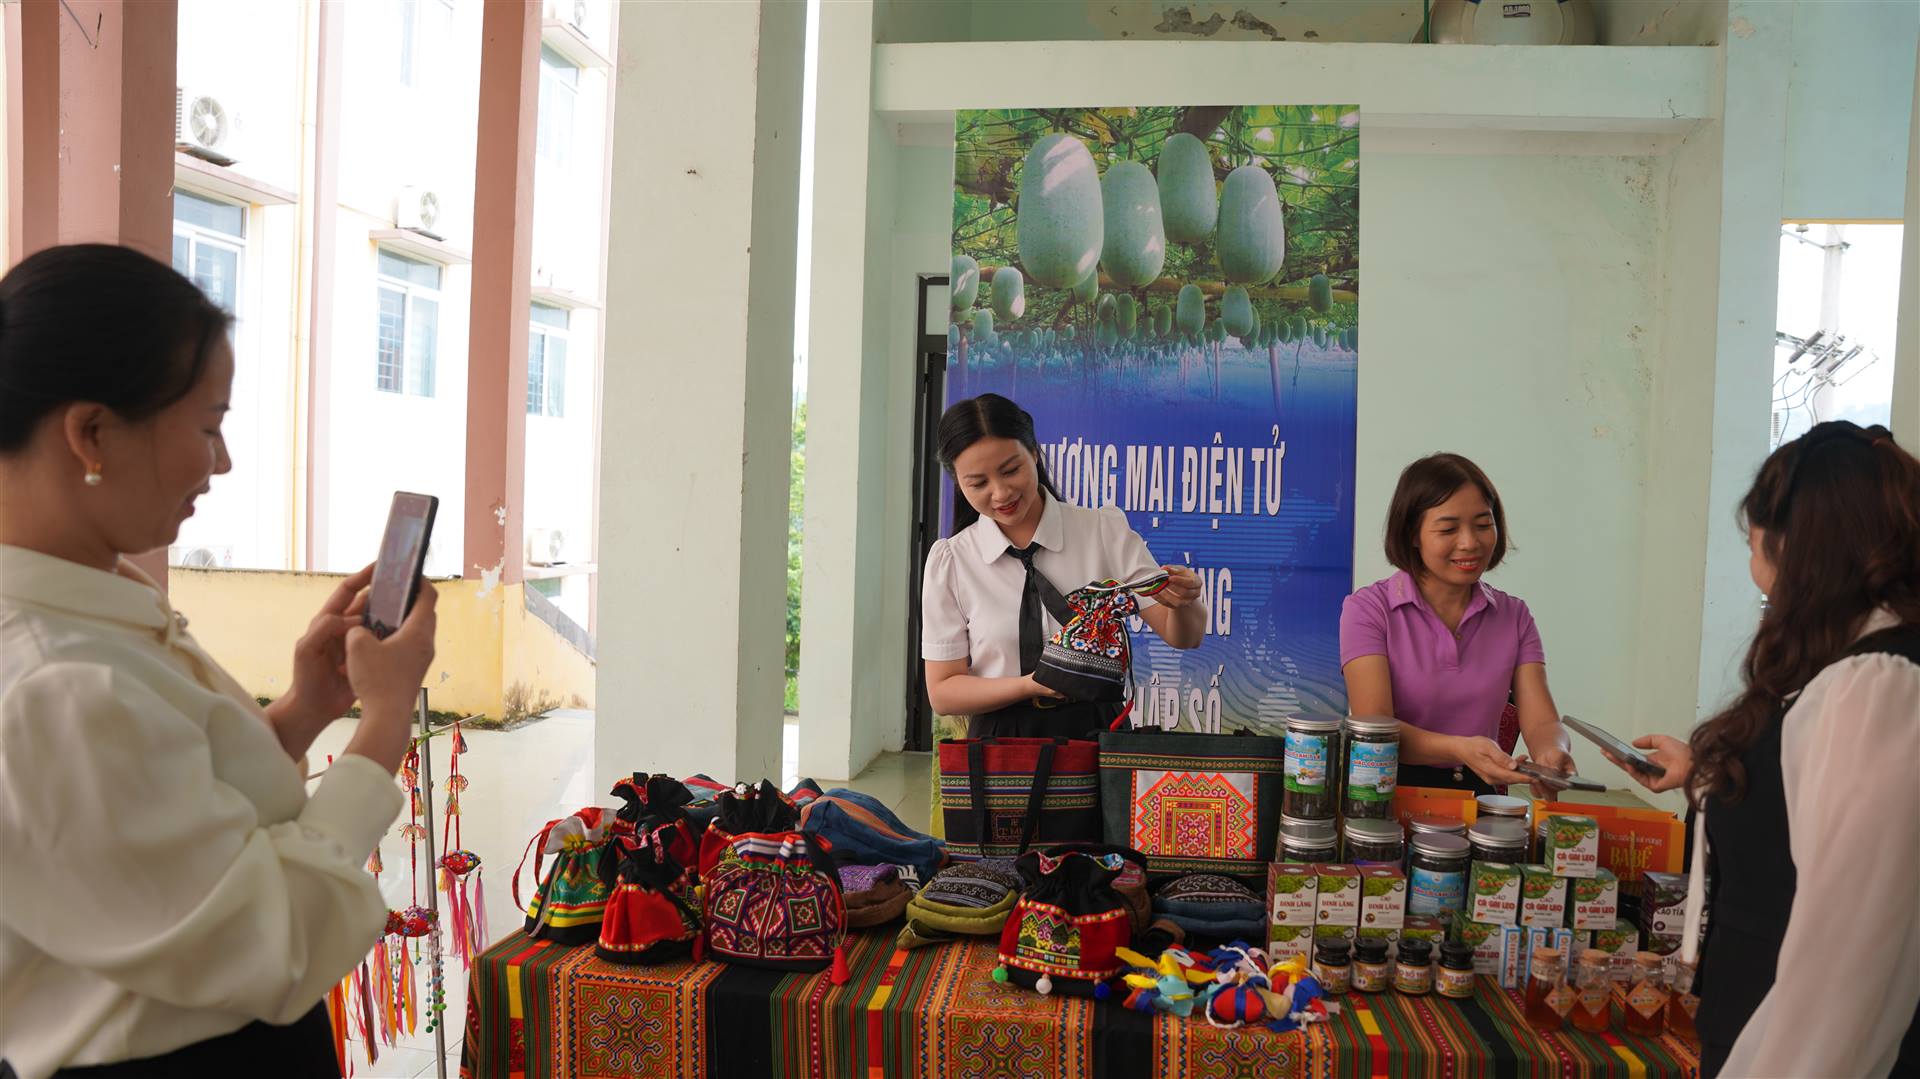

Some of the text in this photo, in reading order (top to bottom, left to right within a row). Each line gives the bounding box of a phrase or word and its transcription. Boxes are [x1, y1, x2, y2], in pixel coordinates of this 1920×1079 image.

[1125, 445, 1175, 528] MẠI
[1181, 432, 1244, 529] ĐIỆN
[1251, 424, 1286, 516] TỬ
